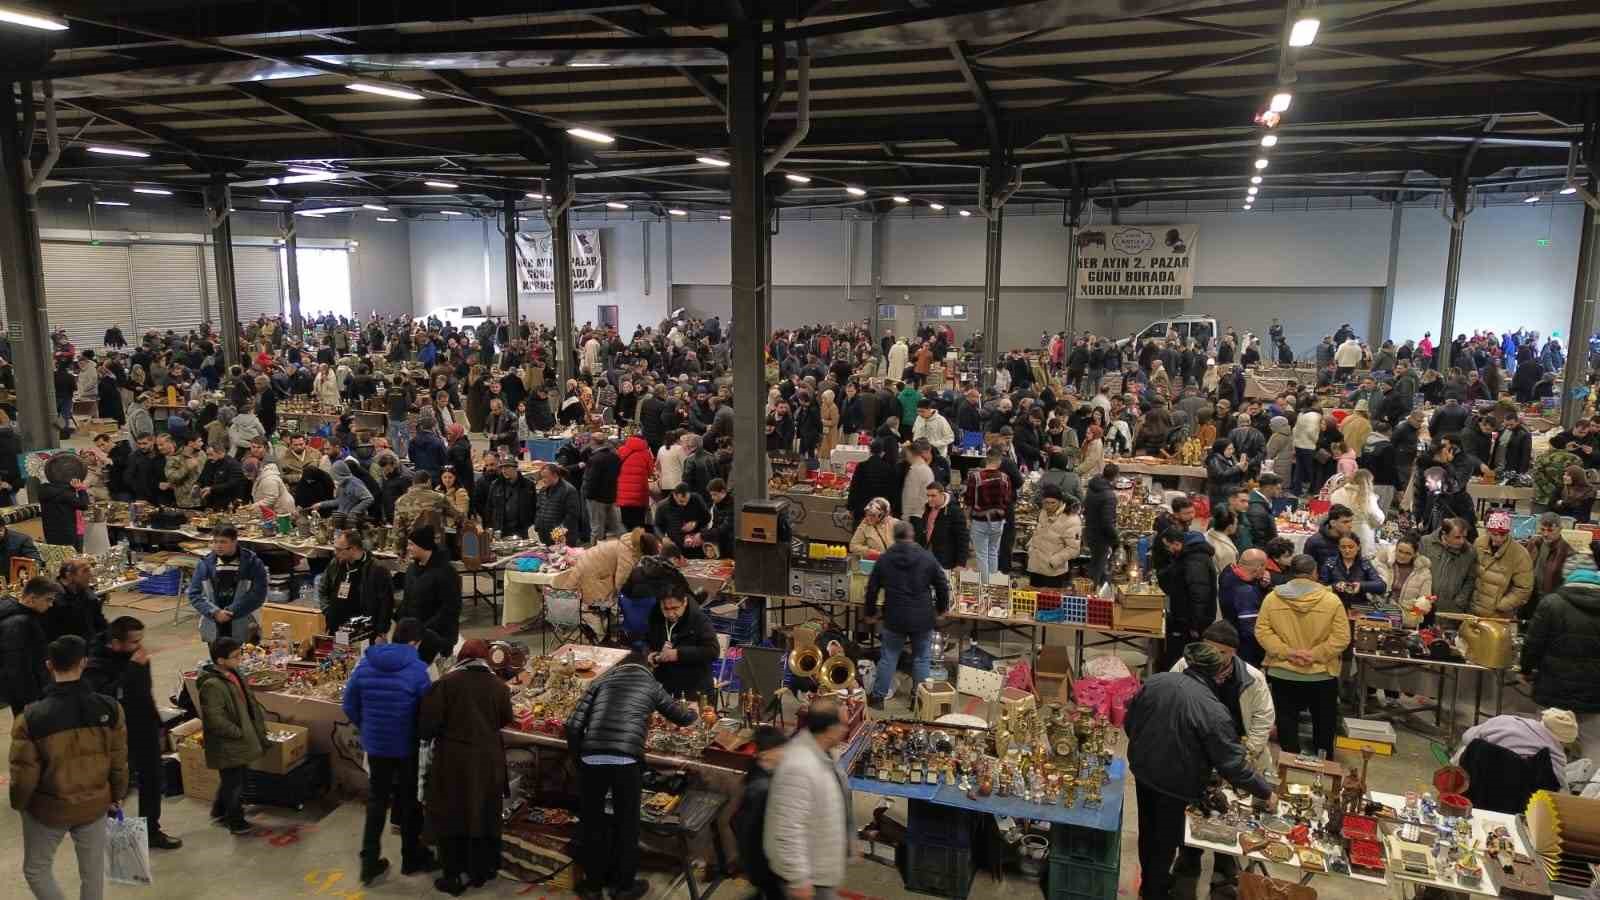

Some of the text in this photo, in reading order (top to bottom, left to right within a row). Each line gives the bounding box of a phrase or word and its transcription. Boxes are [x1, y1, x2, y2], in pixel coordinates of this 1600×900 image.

[1077, 257, 1098, 269] HER
[1102, 257, 1129, 268] AYIN
[1151, 257, 1189, 268] PAZAR
[1088, 269, 1175, 283] GÜNÜ BURADA
[1081, 285, 1182, 296] KURULMAKTADIR
